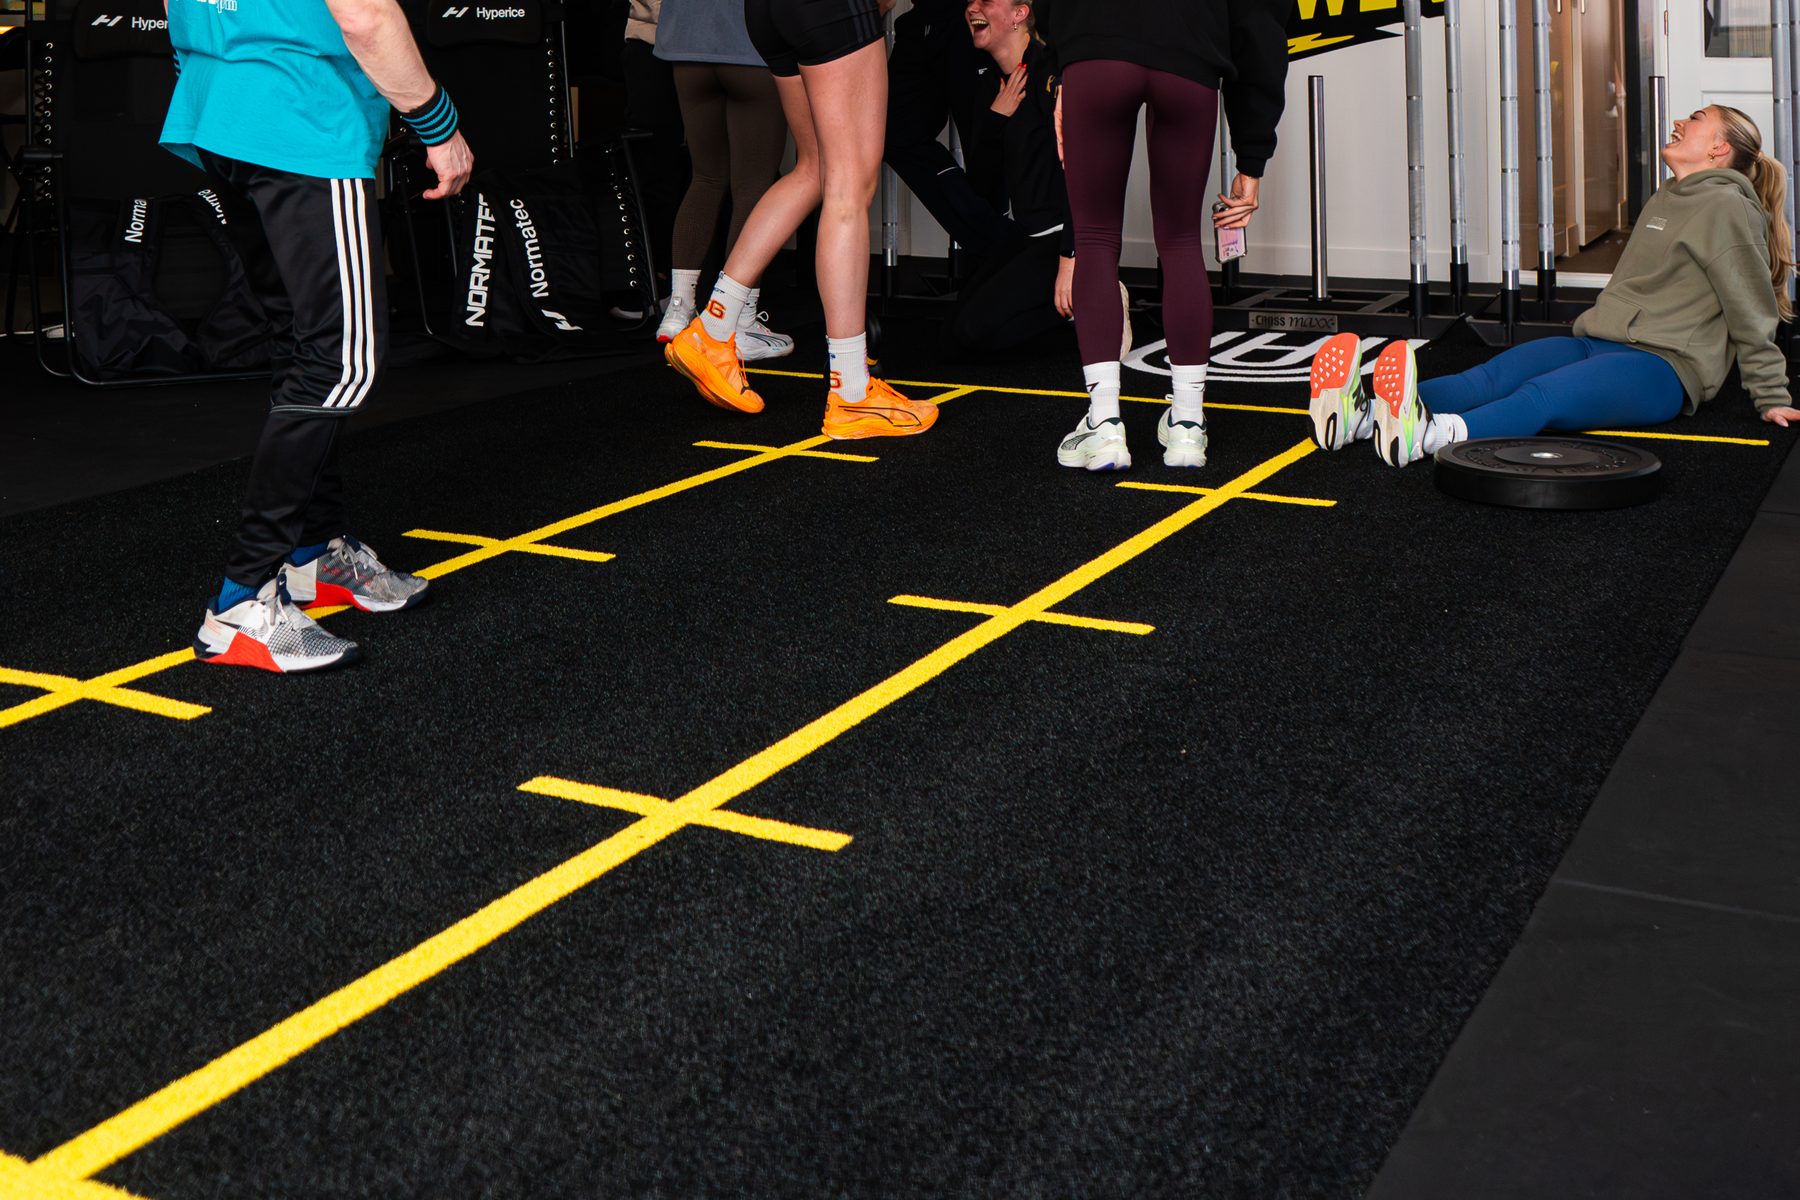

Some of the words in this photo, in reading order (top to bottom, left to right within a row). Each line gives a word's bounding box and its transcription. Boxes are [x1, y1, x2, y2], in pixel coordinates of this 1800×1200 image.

[132, 17, 169, 31] Hyper
[476, 6, 525, 20] Hyperice
[124, 198, 148, 243] Norma
[510, 198, 549, 298] Normatec
